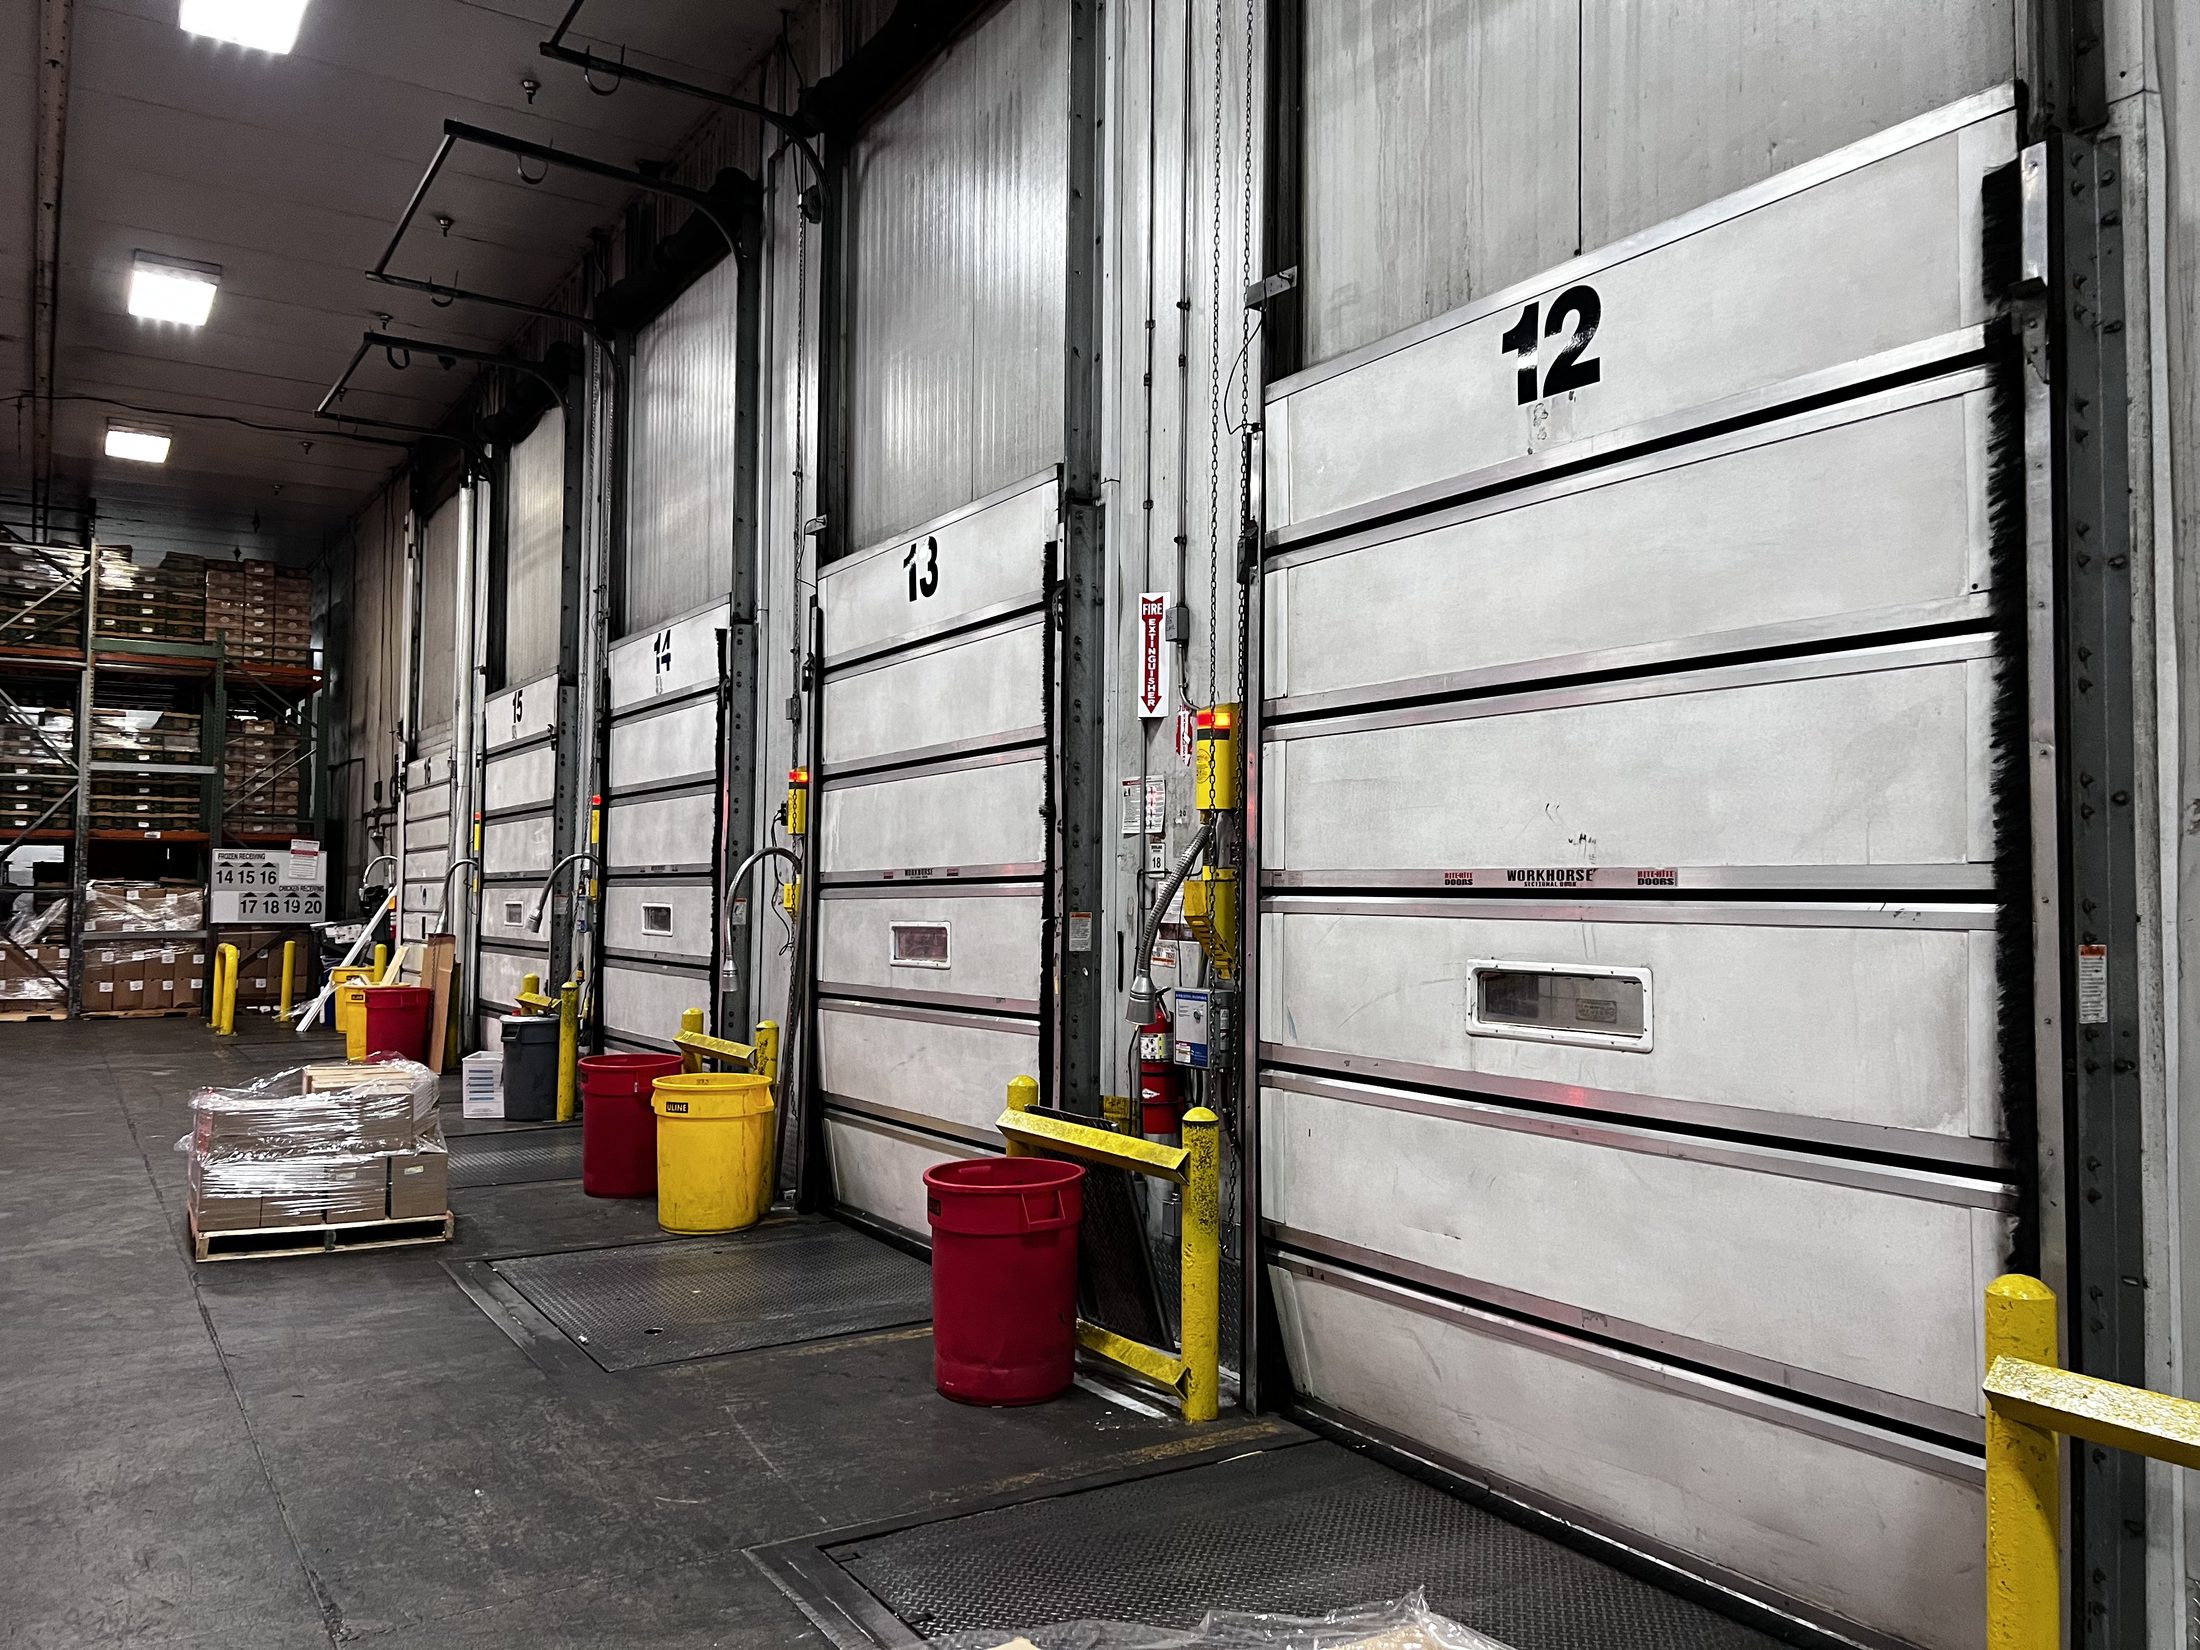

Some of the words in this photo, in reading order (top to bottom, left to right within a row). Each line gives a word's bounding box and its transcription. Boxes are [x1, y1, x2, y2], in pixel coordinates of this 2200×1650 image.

[1502, 284, 1602, 406] 12
[902, 535, 939, 602] 13
[1142, 603, 1163, 616] FIRE
[653, 629, 672, 675] 14
[1147, 618, 1157, 707] EXTINGUISHER
[512, 689, 524, 724] 15
[218, 852, 239, 860] FROZEN
[1152, 856, 1161, 868] 18
[216, 870, 234, 884] 14
[238, 870, 255, 884] 15
[260, 870, 277, 885] 16
[1444, 878, 1473, 886] DOORS
[1507, 868, 1597, 882] WORKHORSE
[1637, 877, 1674, 886] DOORS
[240, 899, 258, 914] 17
[262, 900, 280, 915] 18
[283, 899, 301, 914] 19
[304, 900, 322, 915] 20
[666, 1103, 687, 1112] ULINE
